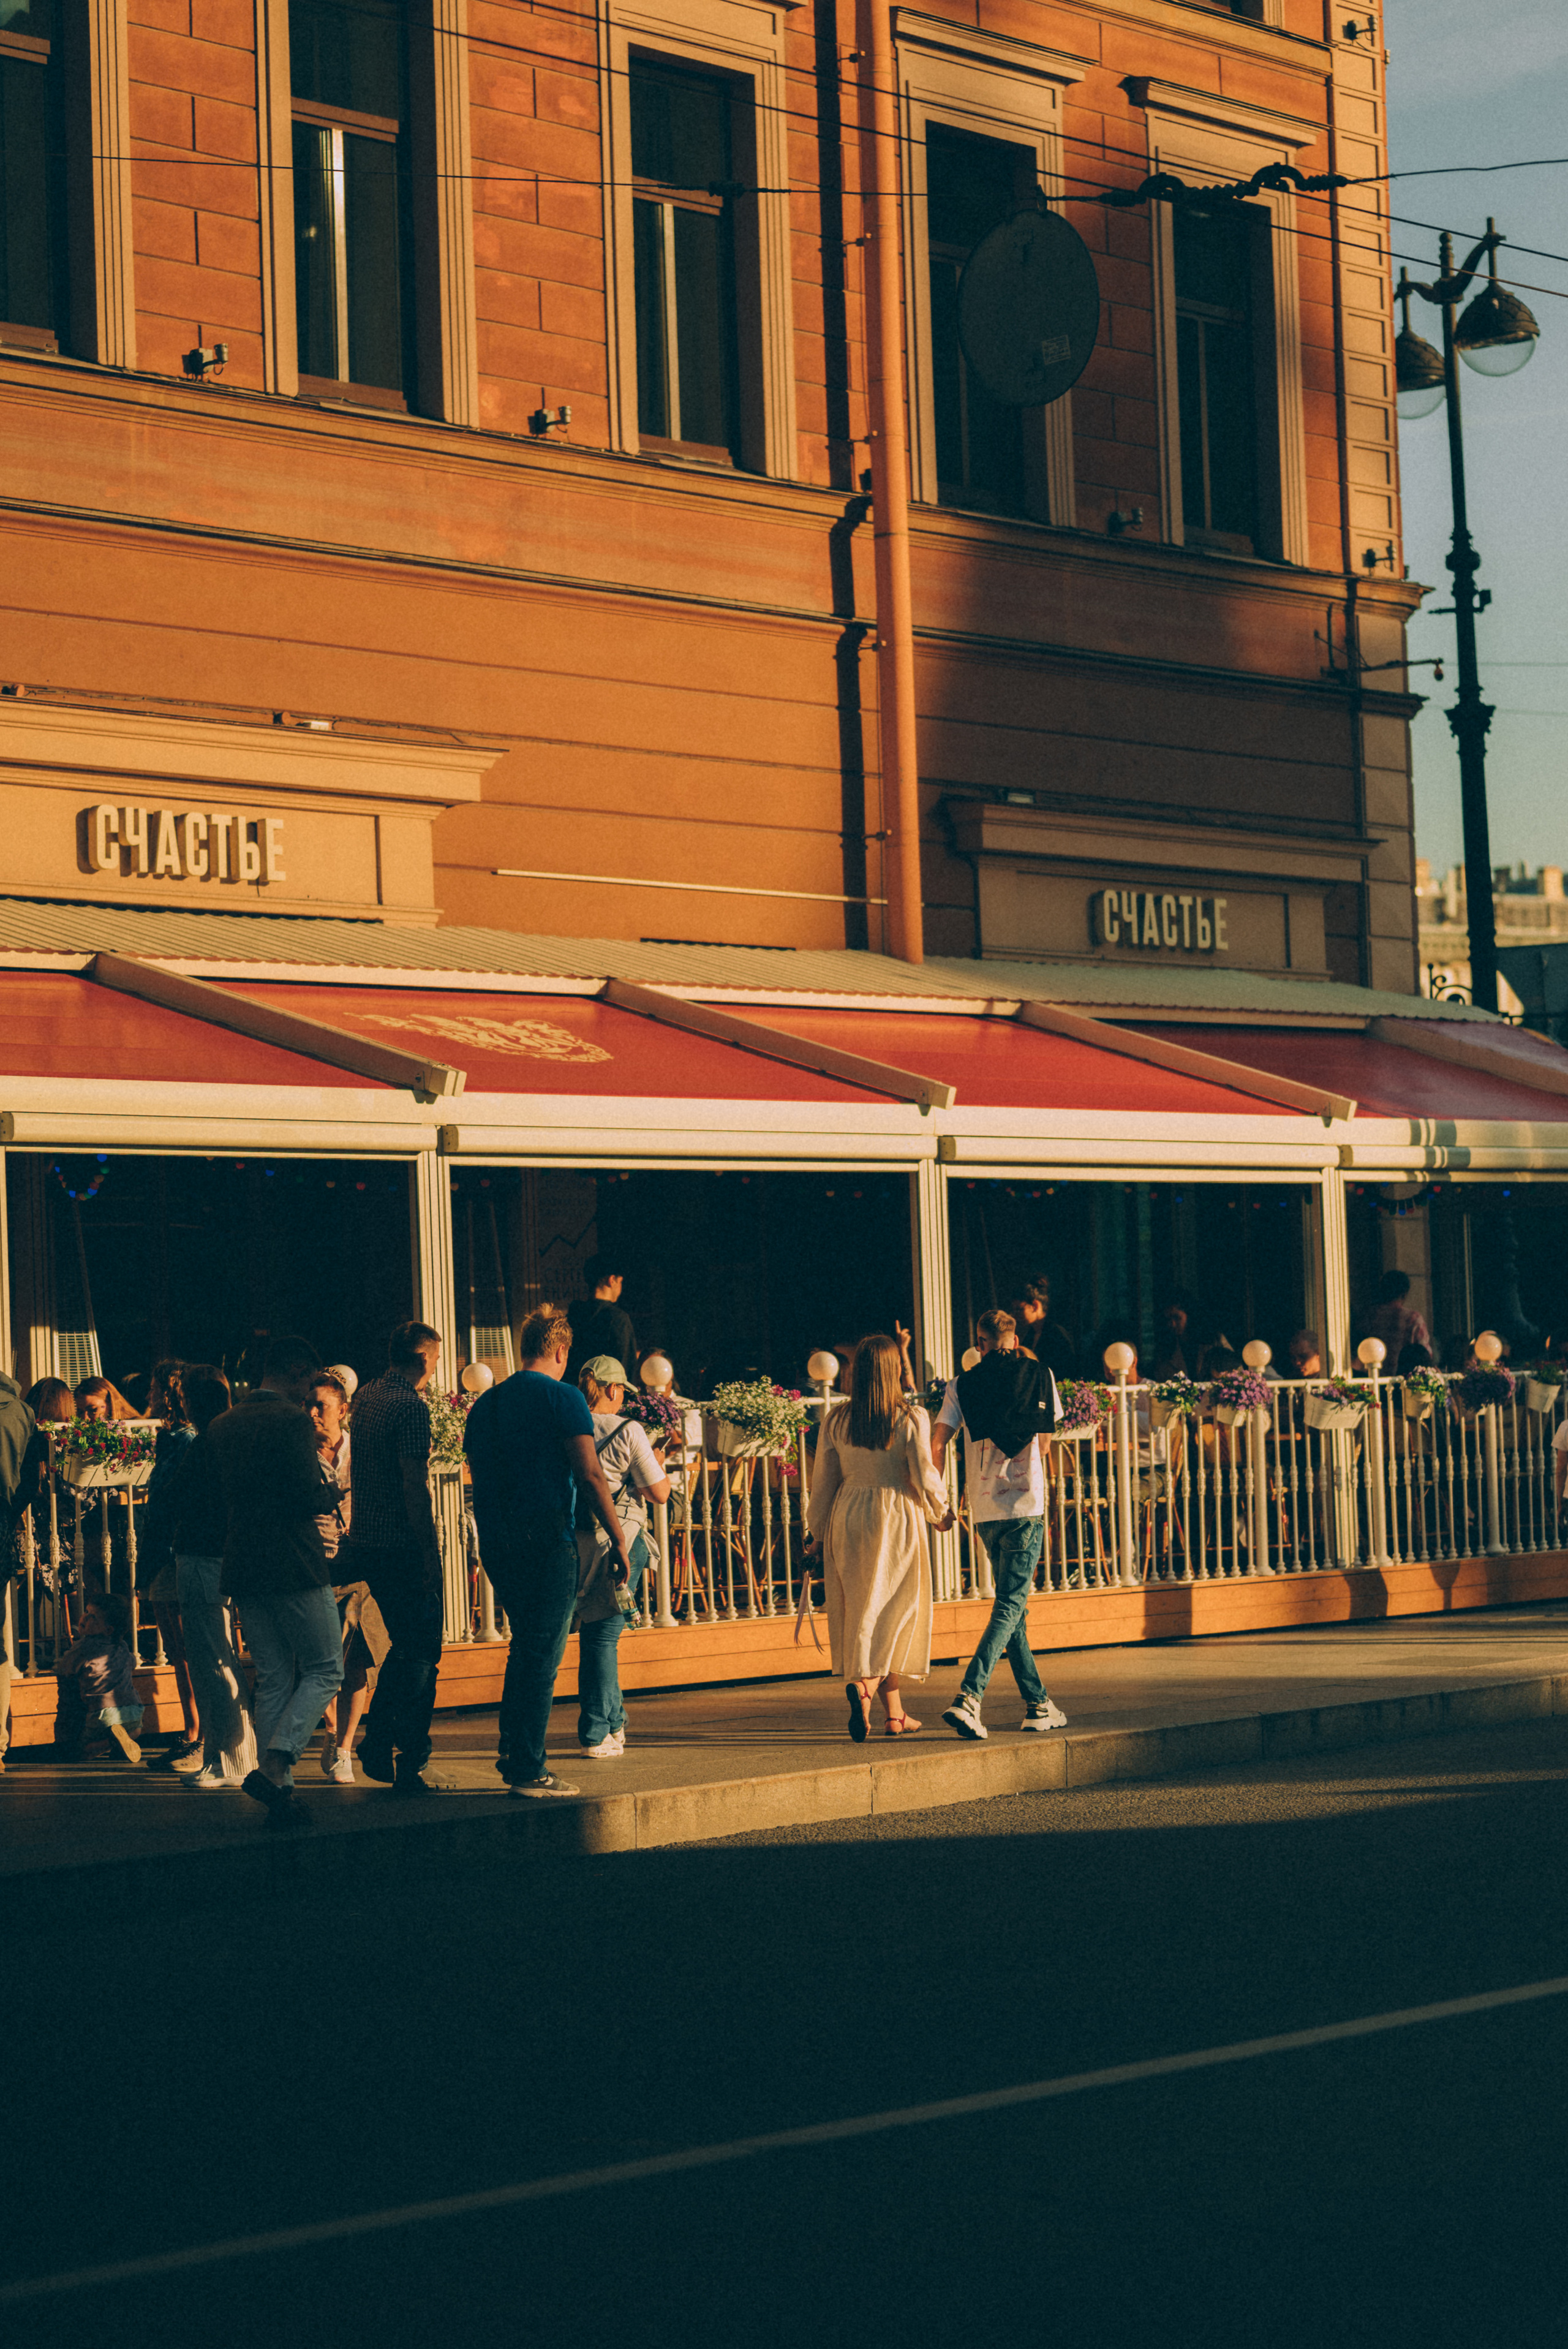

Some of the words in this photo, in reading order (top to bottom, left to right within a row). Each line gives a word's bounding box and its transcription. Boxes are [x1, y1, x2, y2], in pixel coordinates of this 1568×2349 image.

[94, 804, 287, 882] СЧАСТЬЕ
[1103, 888, 1229, 950] СЧАСТЬЕ
[544, 1267, 582, 1284] СЕРГЕ
